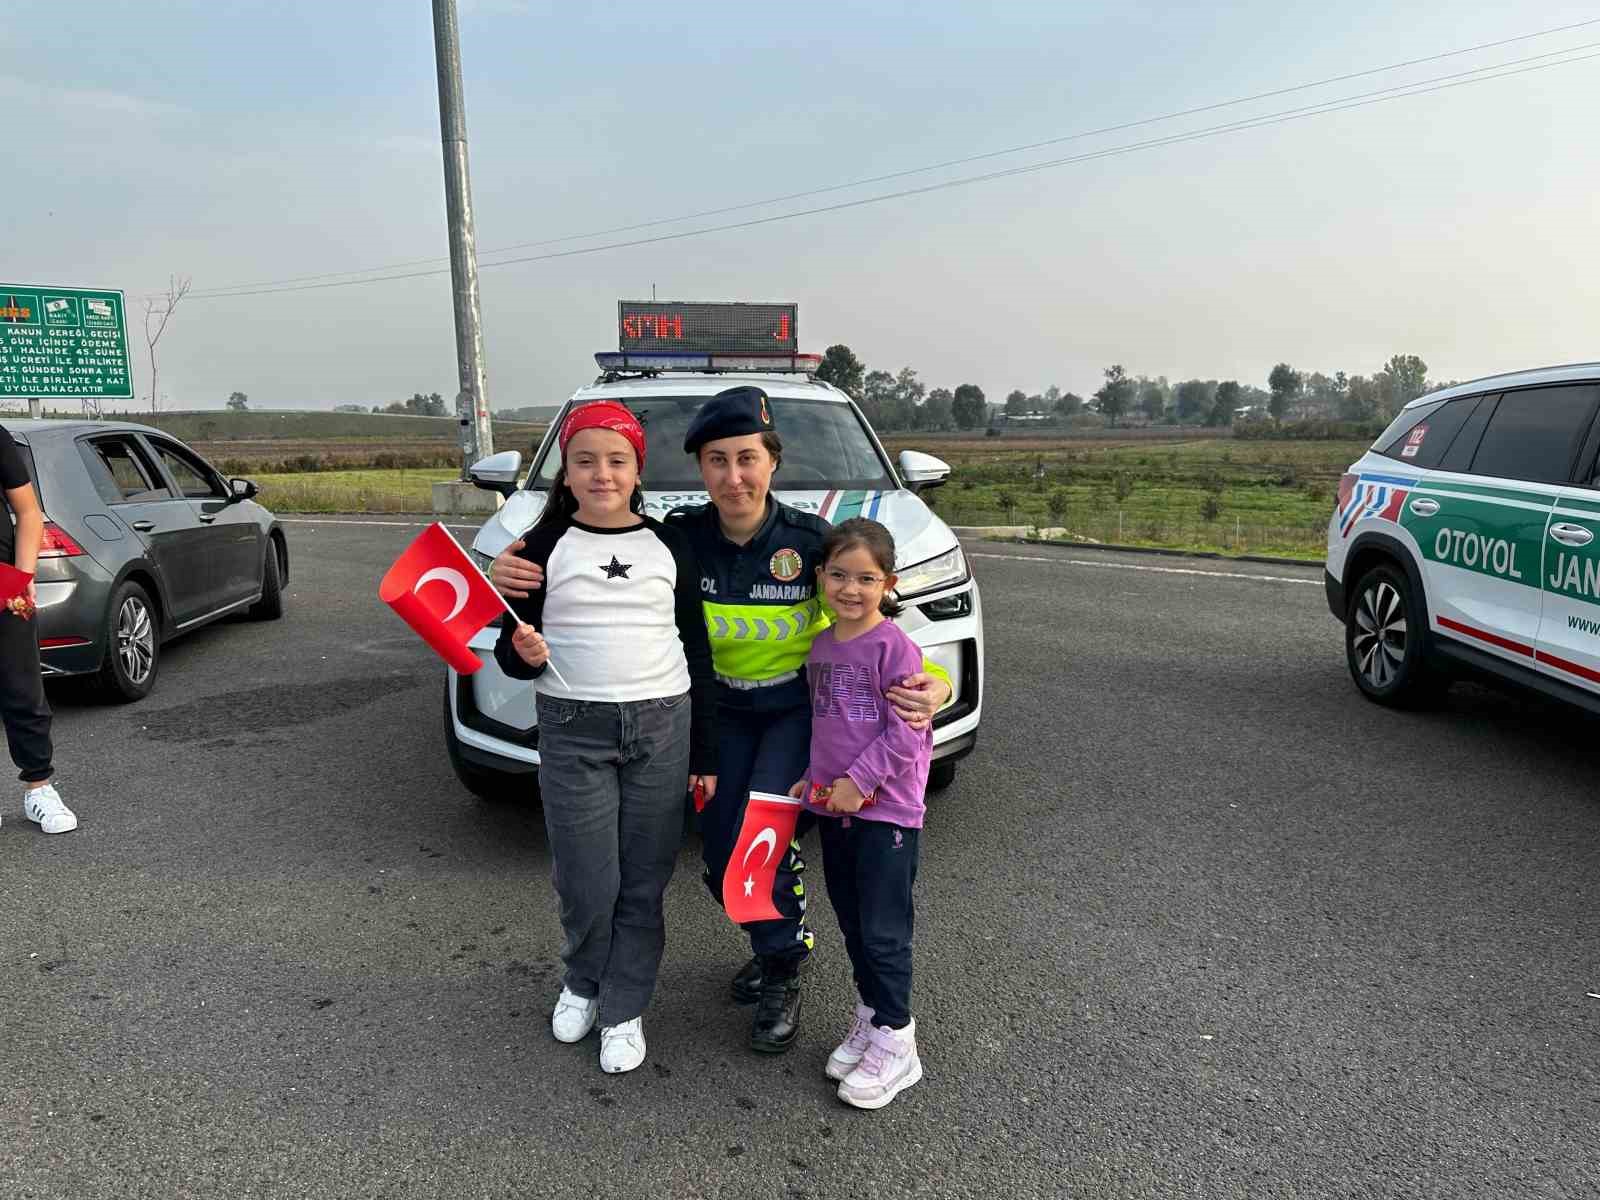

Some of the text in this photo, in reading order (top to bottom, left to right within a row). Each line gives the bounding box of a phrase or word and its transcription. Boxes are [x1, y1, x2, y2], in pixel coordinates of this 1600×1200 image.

[7, 328, 42, 336] KANUN
[10, 337, 33, 346] GÜN
[81, 339, 117, 348] ÖDEME
[95, 348, 123, 357] GÜNE
[12, 355, 50, 364] ÜCRETİ
[55, 356, 73, 365] İLE
[78, 357, 124, 366] BİRLİKTE
[22, 365, 64, 374] GÜNDEN
[68, 367, 103, 375] SONRA
[109, 366, 125, 375] İSE
[22, 375, 39, 384] İLE
[43, 376, 91, 385] BİRLİKTE
[95, 377, 103, 385] 4
[106, 377, 125, 385] KAT
[4, 384, 104, 393] UYGULANACAKTIR
[1435, 527, 1600, 599] OTOYOL JAN
